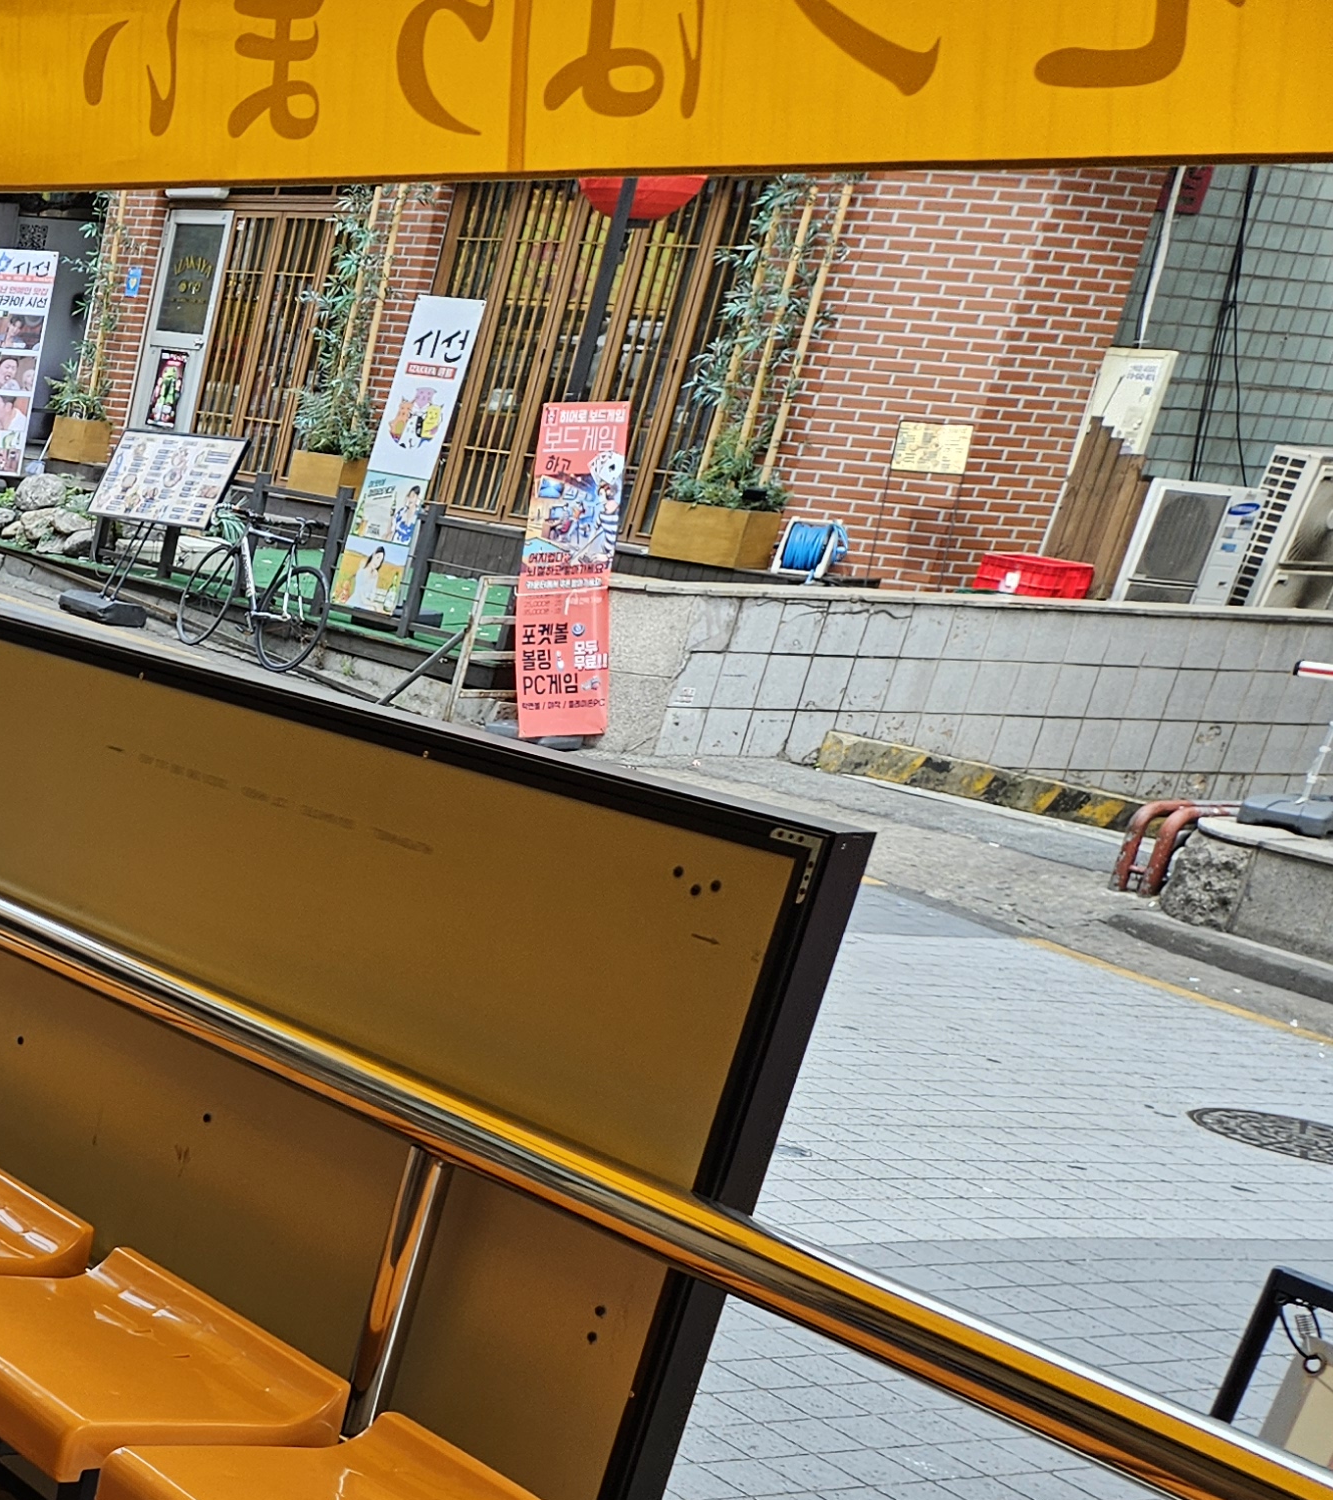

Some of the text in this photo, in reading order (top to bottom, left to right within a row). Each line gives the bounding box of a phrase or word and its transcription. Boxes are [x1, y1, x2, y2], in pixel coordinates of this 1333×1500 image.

[13, 260, 50, 278] 시선
[25, 297, 48, 308] 시선
[412, 329, 471, 363] 시선
[588, 408, 627, 423] 보드게임
[542, 426, 618, 453] 보드게임
[545, 454, 571, 473] 하고
[521, 622, 569, 645] 포켓볼
[574, 640, 599, 655] 모두
[521, 649, 552, 671] 볼링
[522, 672, 579, 696] PC게임
